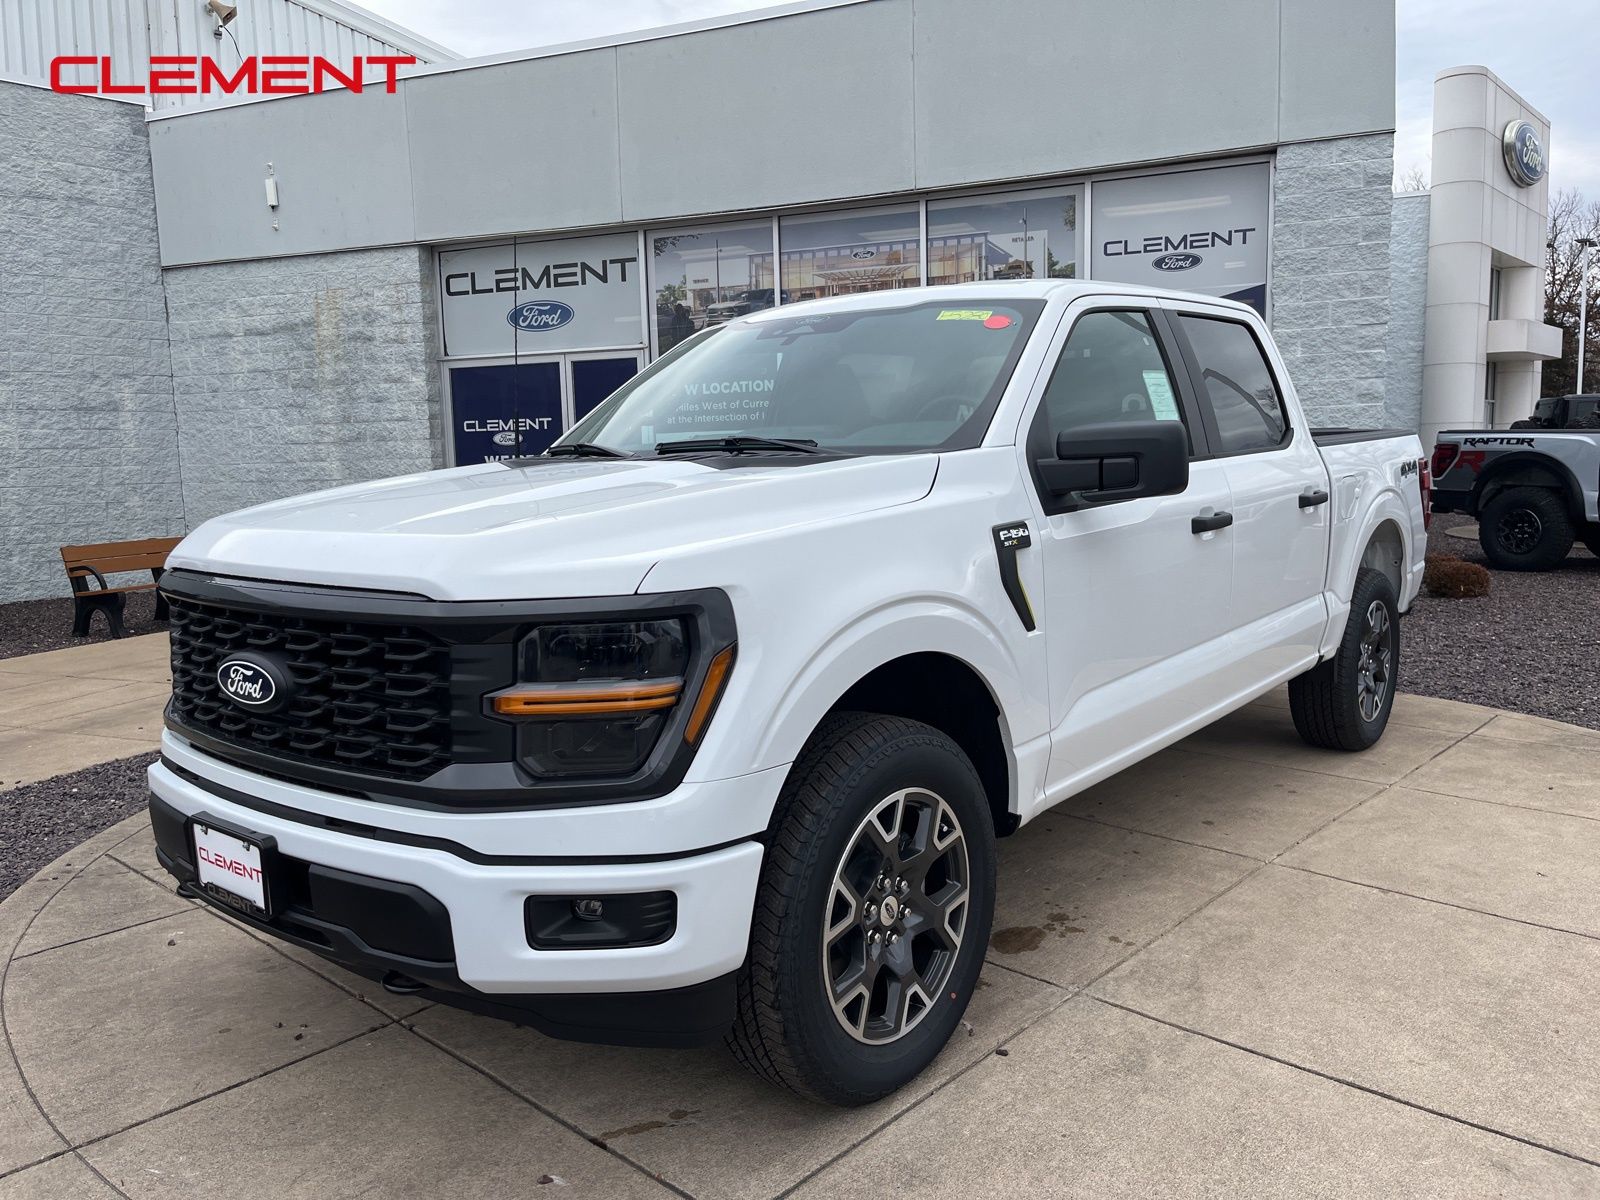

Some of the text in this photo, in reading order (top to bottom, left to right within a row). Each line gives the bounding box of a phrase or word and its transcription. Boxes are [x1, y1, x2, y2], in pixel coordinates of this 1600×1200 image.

[1103, 227, 1256, 257] CLEMENT
[1161, 255, 1193, 269] Ford
[445, 257, 637, 297] CLEMENT
[518, 305, 562, 327] Ford
[702, 379, 775, 395] LOCATION
[702, 401, 727, 411] West
[730, 400, 740, 409] of
[463, 417, 552, 432] CLEMENT
[678, 415, 693, 424] the
[694, 412, 748, 423] Intersection
[750, 411, 760, 420] of
[1463, 437, 1535, 448] RAPTOR
[999, 527, 1029, 541] F-150
[1004, 539, 1018, 547] STX
[198, 846, 263, 883] CLEMENT
